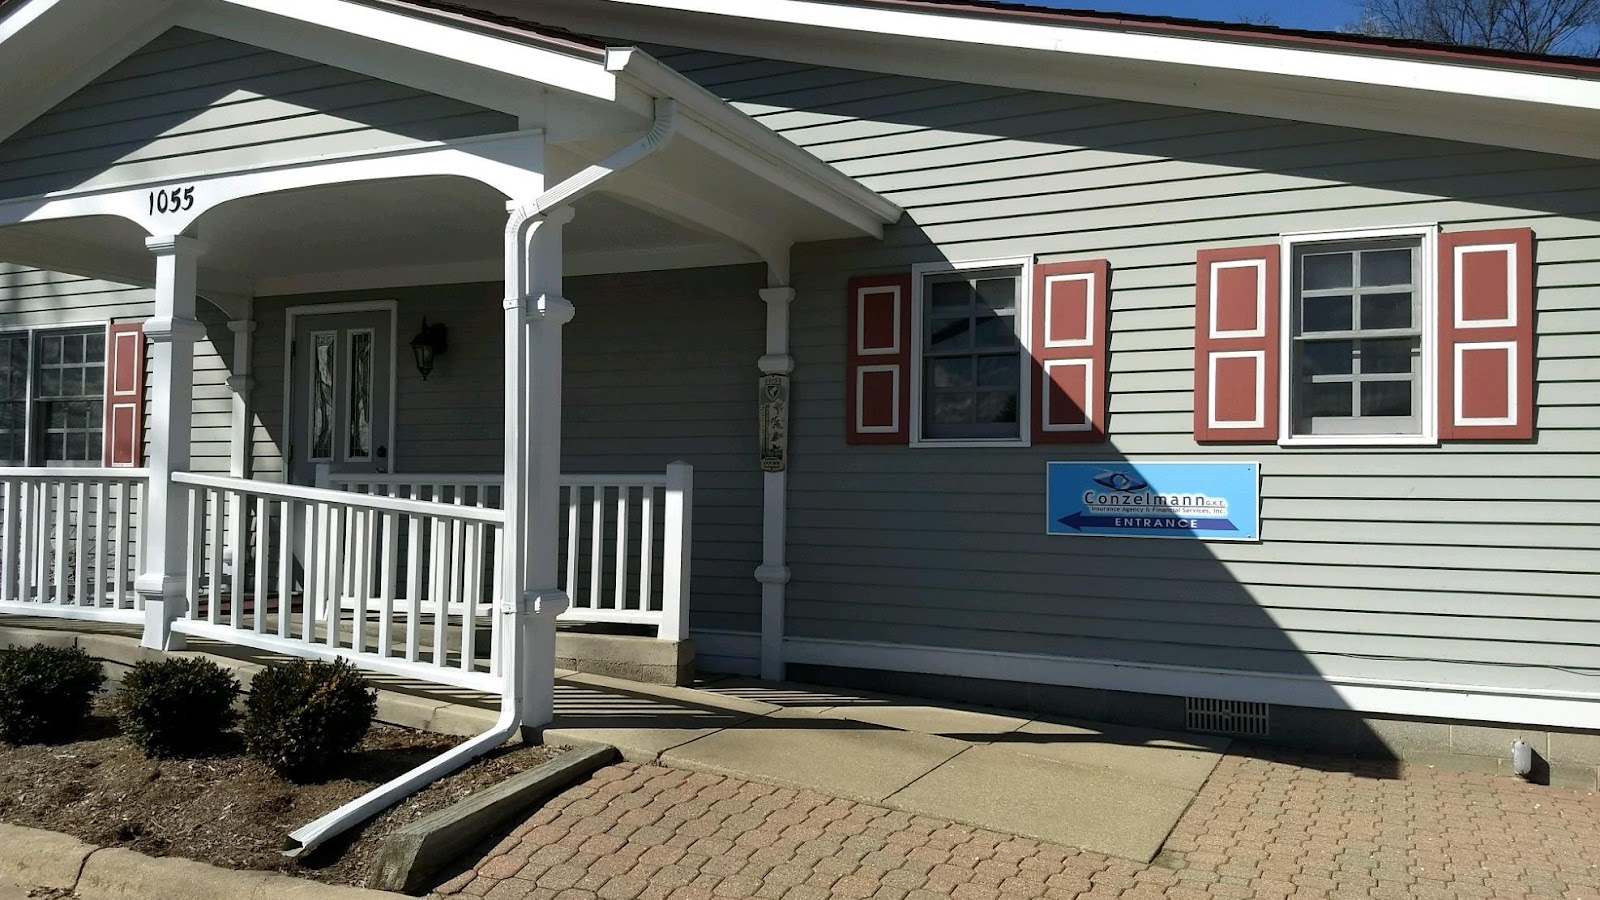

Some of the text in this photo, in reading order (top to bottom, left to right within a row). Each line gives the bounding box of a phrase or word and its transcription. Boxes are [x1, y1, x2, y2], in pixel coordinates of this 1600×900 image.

[149, 185, 195, 216] 1055
[1084, 491, 1204, 506] Conzelmann
[1115, 517, 1197, 529] ENTRANCE
